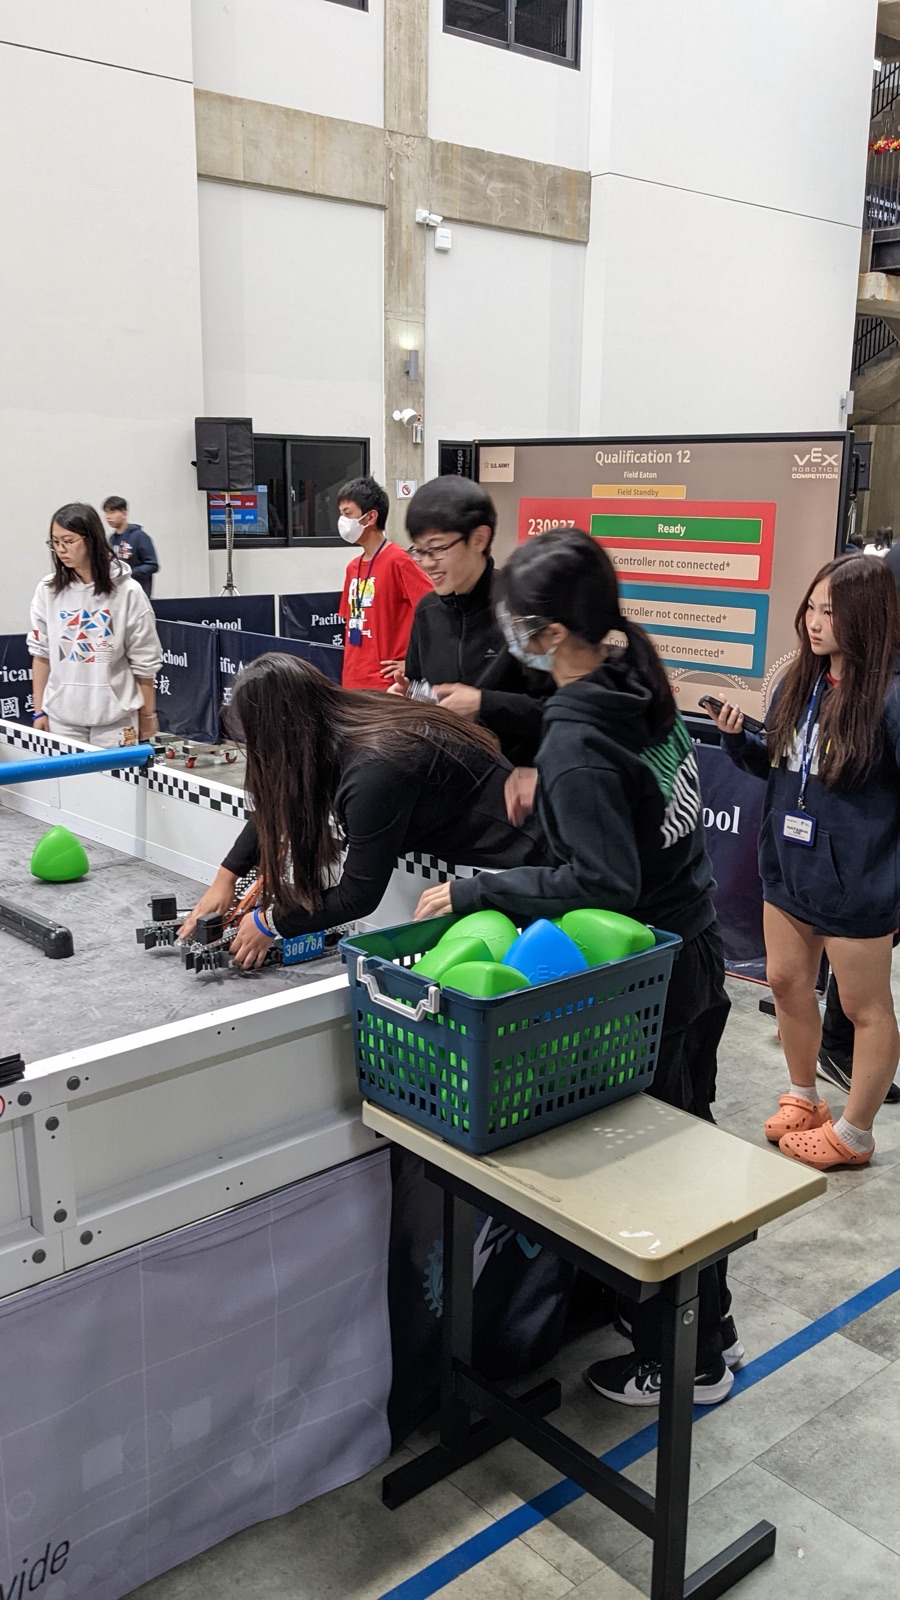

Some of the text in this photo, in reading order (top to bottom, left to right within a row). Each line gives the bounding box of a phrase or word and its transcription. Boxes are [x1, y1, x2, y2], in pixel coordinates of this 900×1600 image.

[595, 449, 691, 466] Qualification 12
[793, 447, 839, 466] VEX
[623, 471, 657, 479] Field Eaton
[617, 488, 659, 498] Field Standby
[657, 523, 687, 537] Ready
[613, 555, 657, 567] Controller
[658, 559, 674, 568] not
[655, 610, 671, 619] not
[285, 936, 323, 957] 30078A
